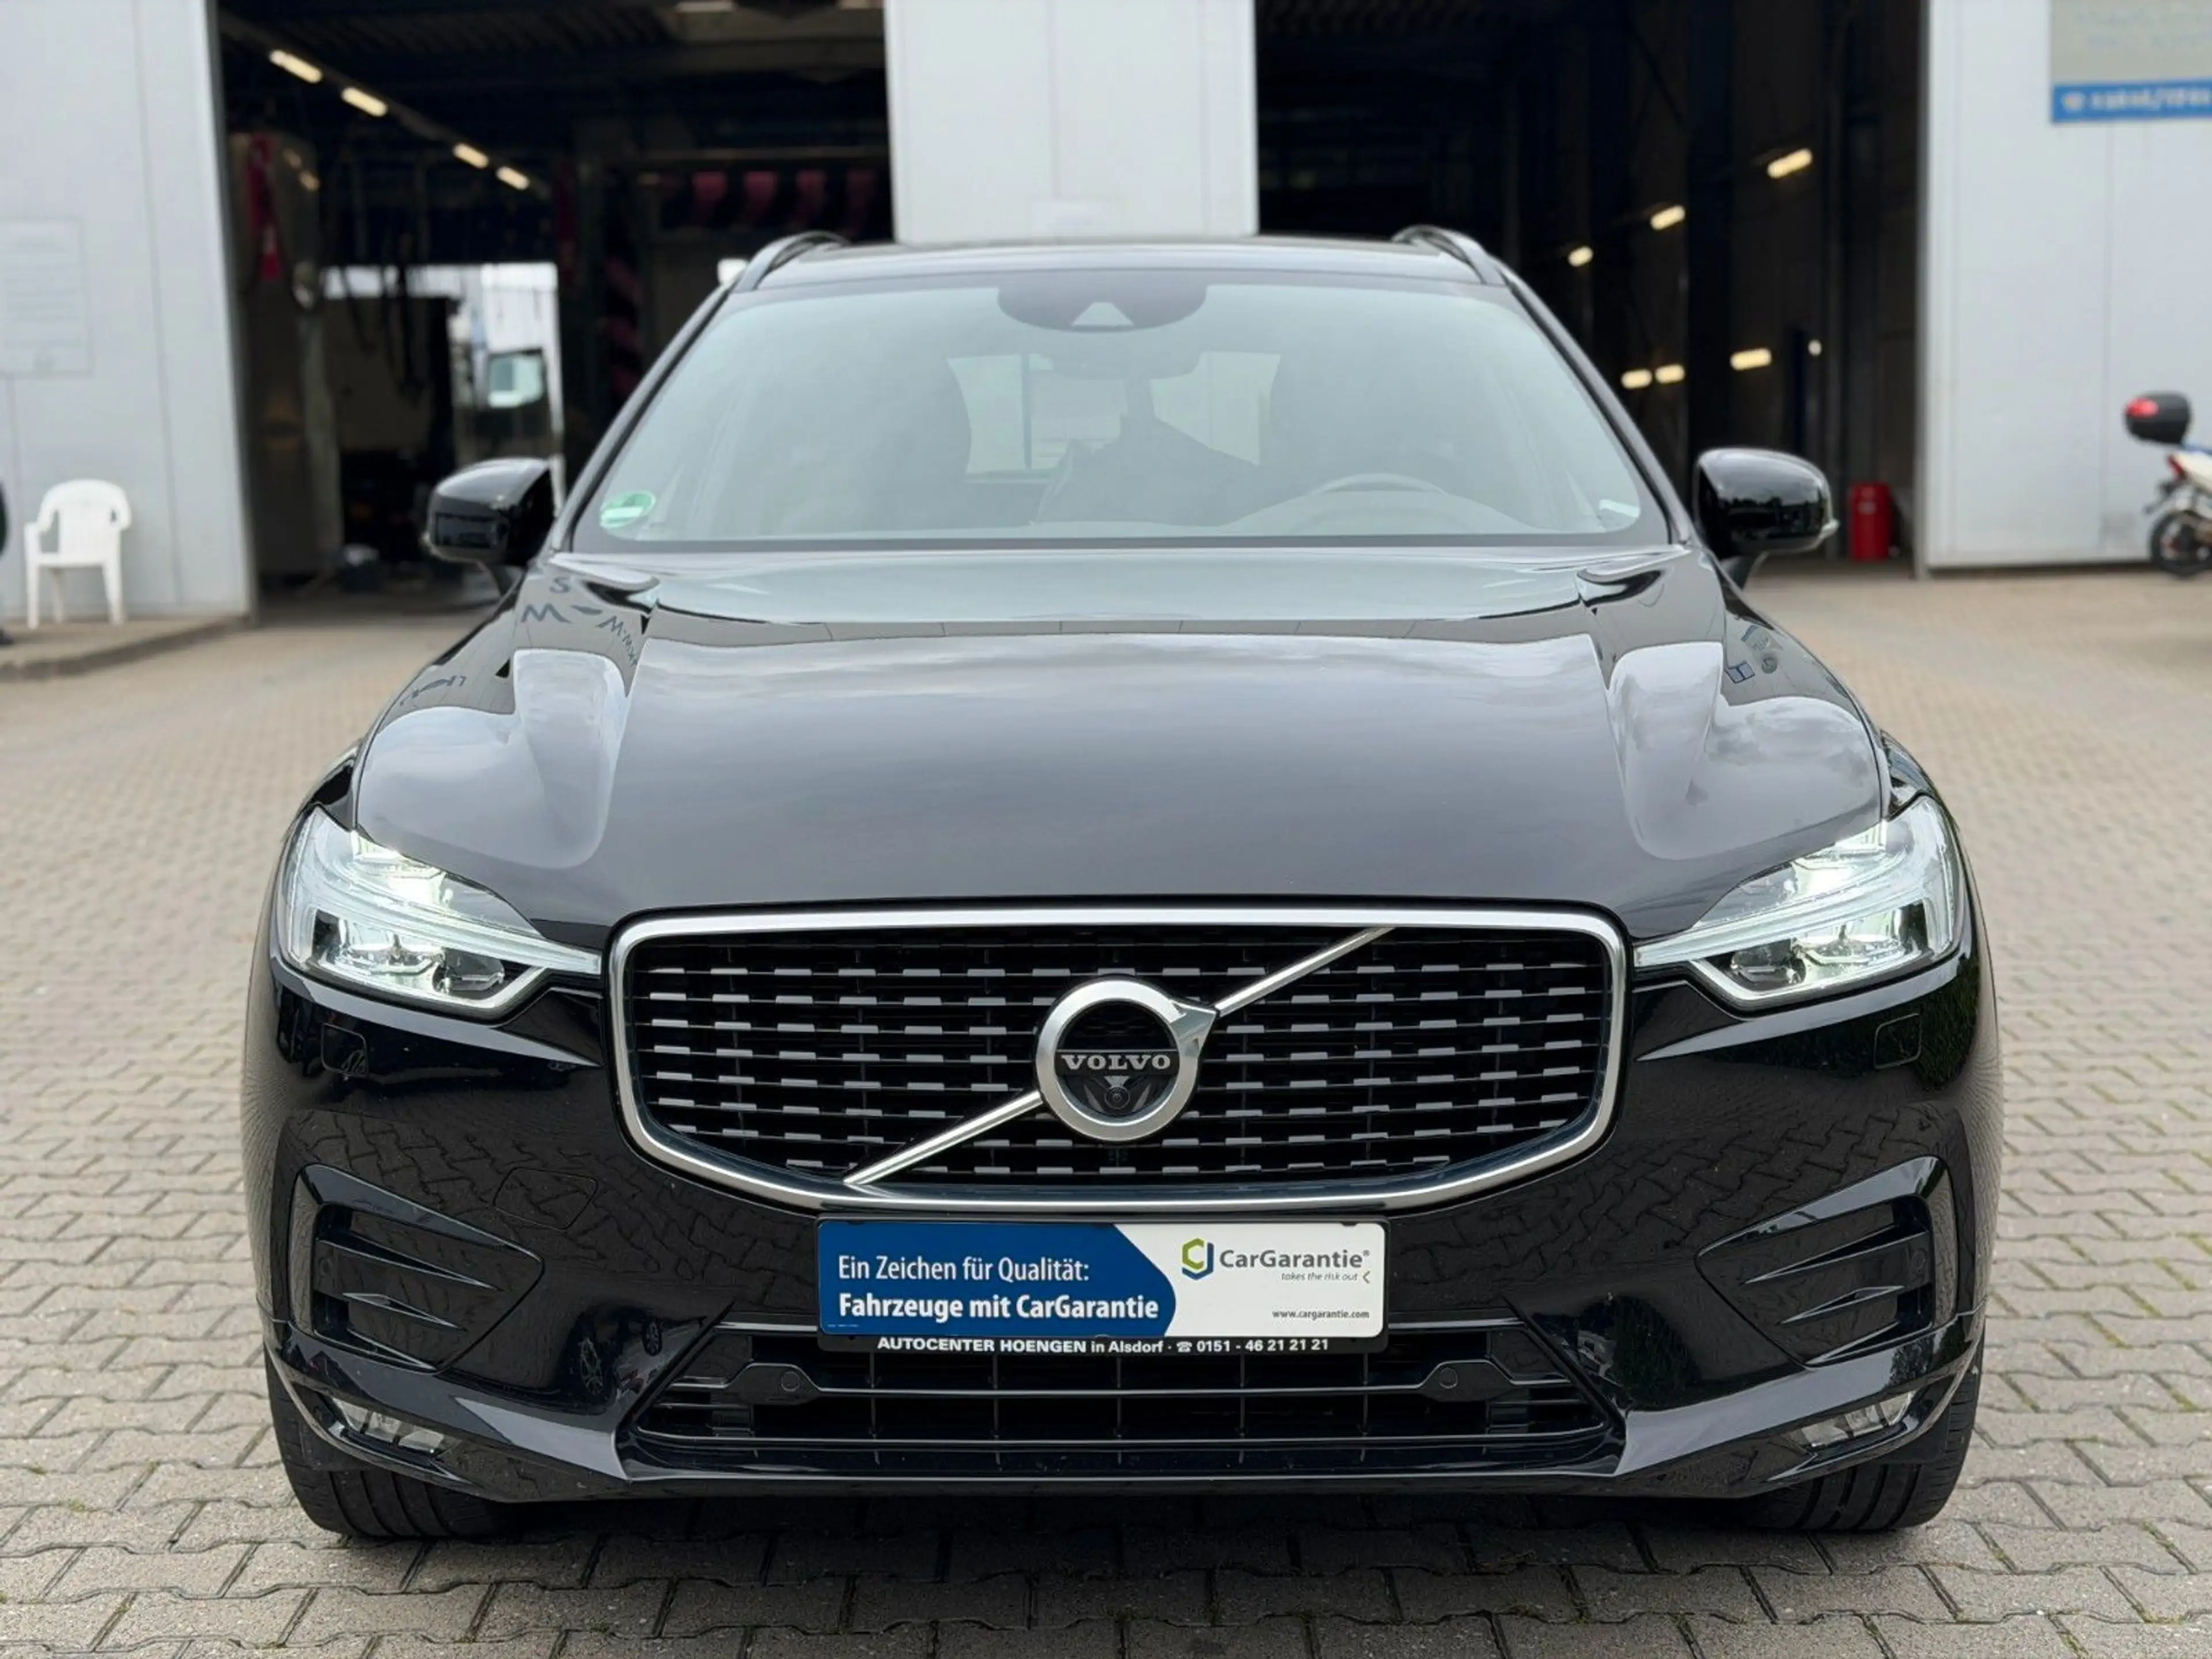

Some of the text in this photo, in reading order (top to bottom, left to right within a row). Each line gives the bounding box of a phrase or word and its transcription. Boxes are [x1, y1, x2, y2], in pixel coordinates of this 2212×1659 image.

[1062, 1055, 1171, 1070] VOLVO
[839, 1255, 1089, 1283] Ein Zeichen für Qualität:
[1281, 1271, 1358, 1282] takes the risk out
[839, 1293, 1160, 1323] Fahrzeuge mit CarGarantie
[1272, 1309, 1370, 1321] www.cargarantie.com
[877, 1336, 995, 1352] AUTOCENTER
[999, 1339, 1087, 1354] HOENGEN
[1090, 1340, 1105, 1353] in
[1107, 1340, 1165, 1354] Alsdorf
[1196, 1340, 1231, 1353] 0151
[1245, 1339, 1263, 1352] 46
[1267, 1339, 1285, 1351] 21
[1289, 1339, 1306, 1351] 21
[1310, 1338, 1328, 1351] 21
